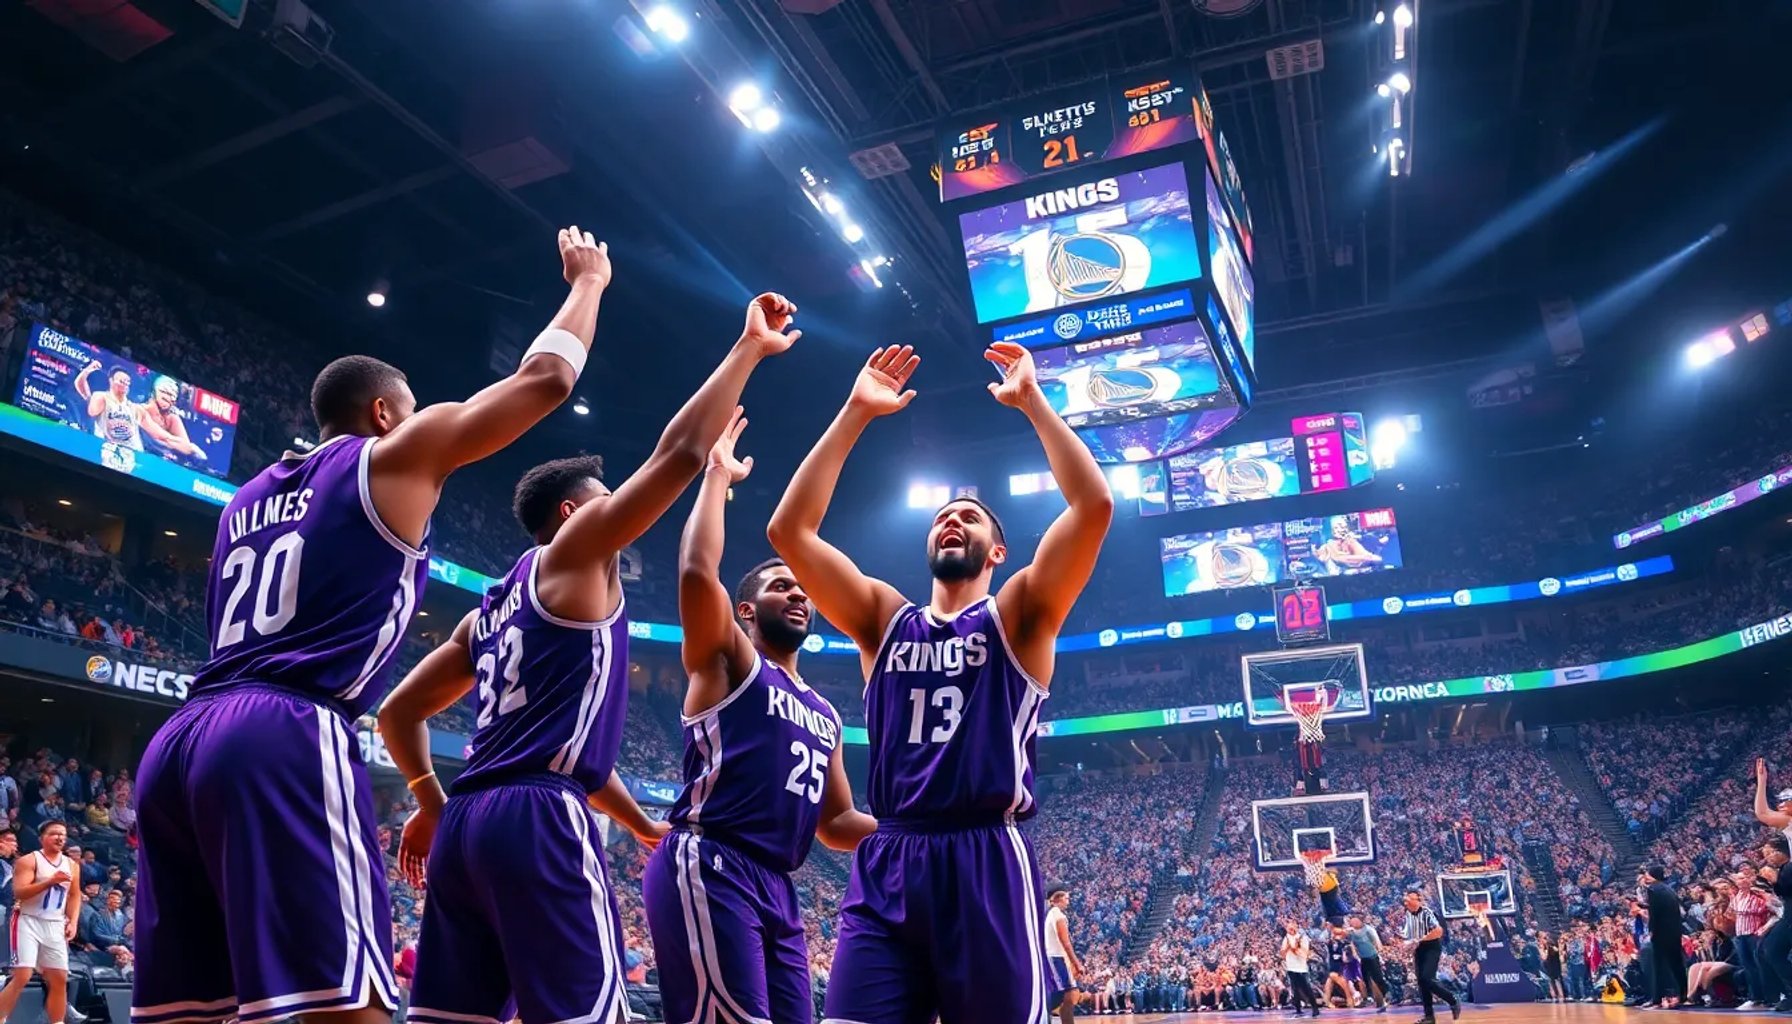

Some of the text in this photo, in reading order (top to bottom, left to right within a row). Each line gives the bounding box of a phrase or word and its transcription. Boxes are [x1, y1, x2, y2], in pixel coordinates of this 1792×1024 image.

[1043, 134, 1079, 169] 21
[1025, 177, 1120, 219] KINGS
[217, 531, 305, 650] 20
[908, 686, 964, 744] 13
[785, 741, 829, 804] 25
